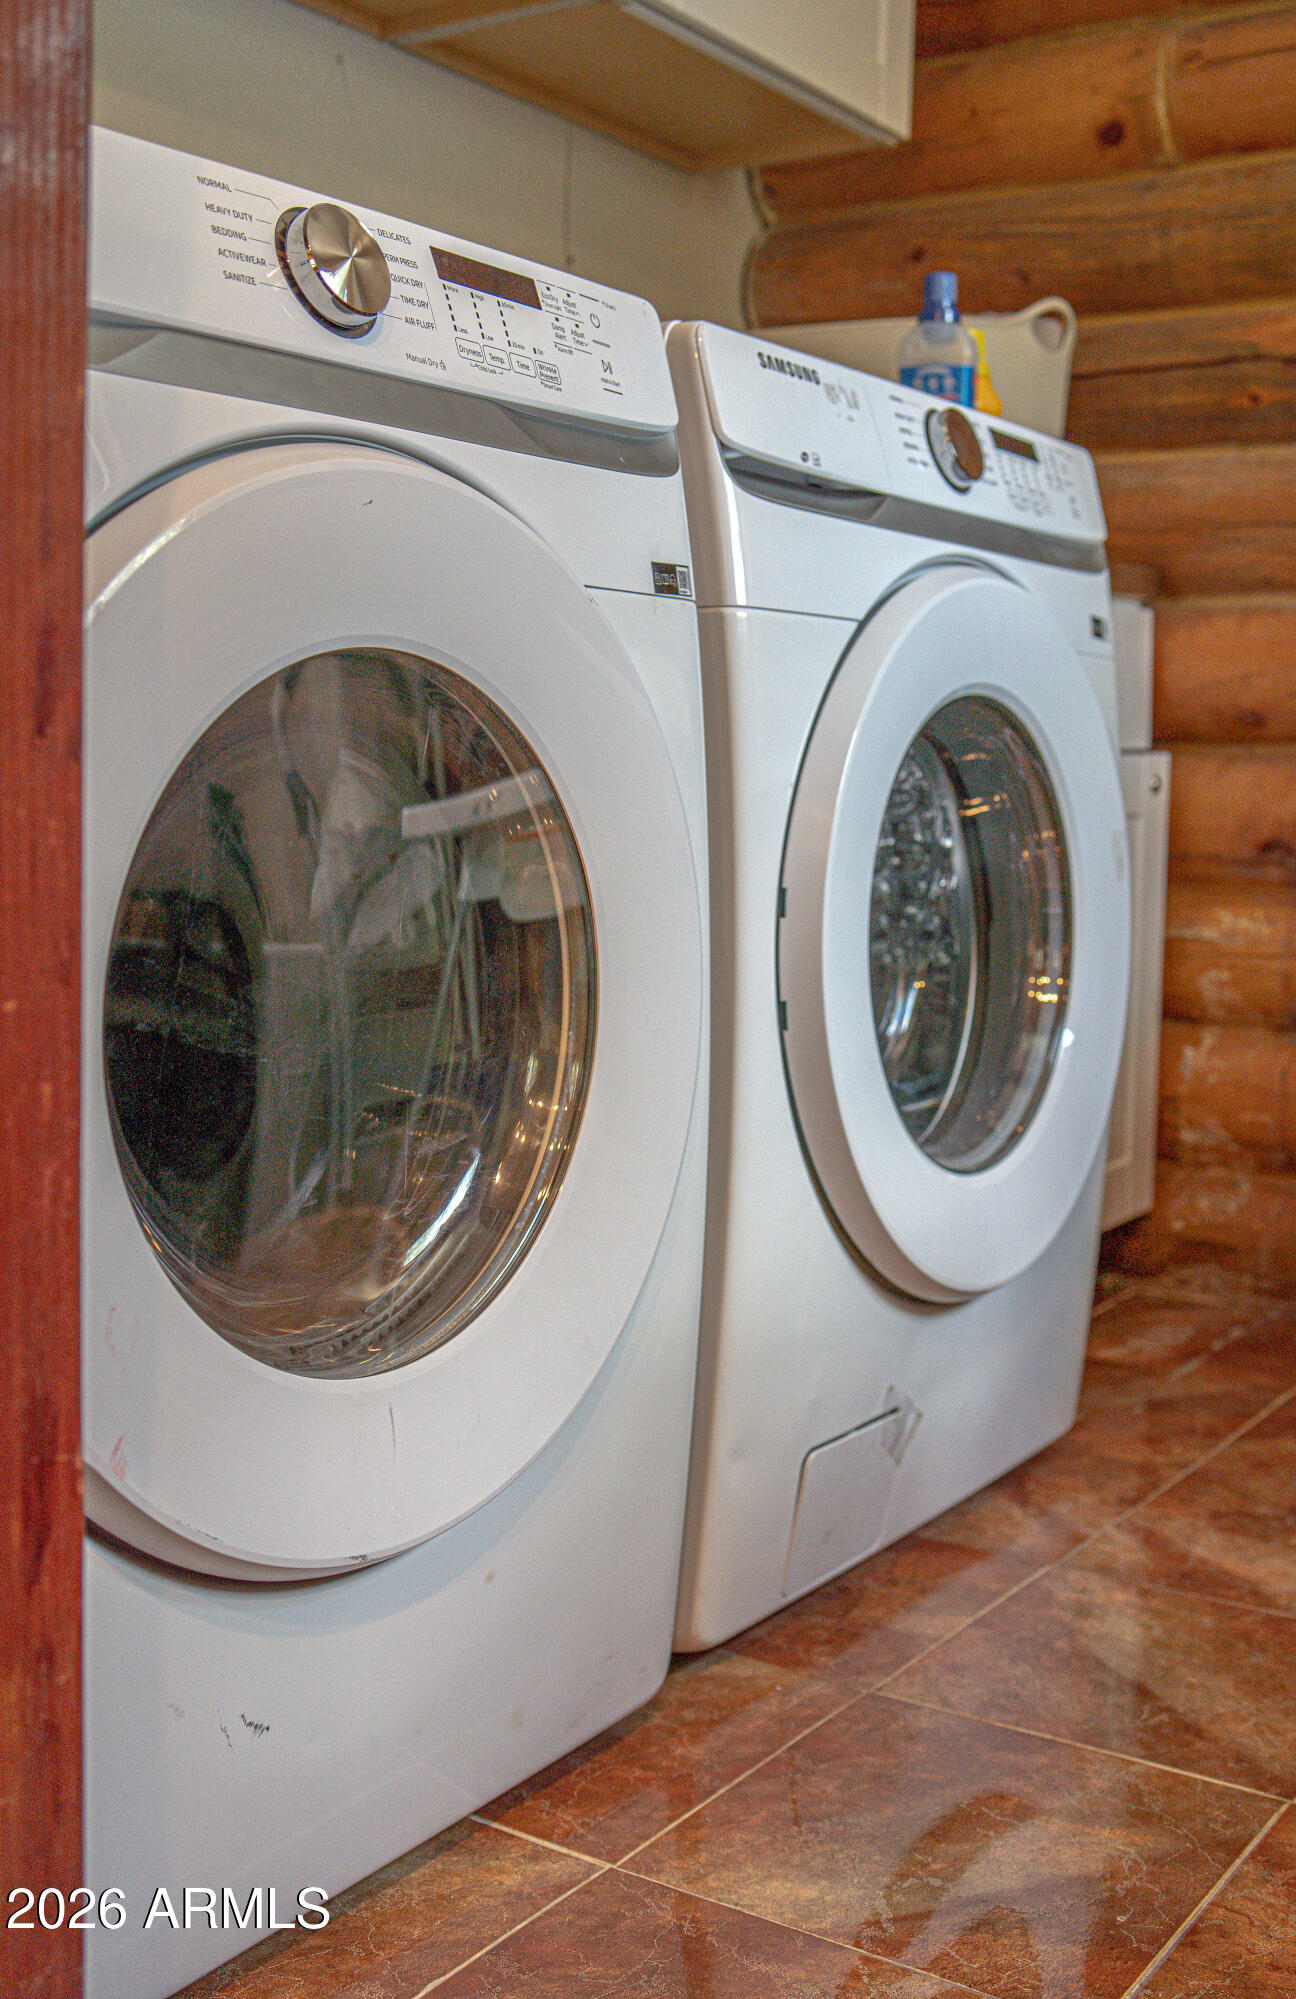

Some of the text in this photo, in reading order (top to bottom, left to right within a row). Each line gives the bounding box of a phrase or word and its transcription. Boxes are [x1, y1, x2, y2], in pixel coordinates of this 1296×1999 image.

[196, 175, 233, 193] NORMAL
[204, 202, 253, 223] HEAVY DUTY
[210, 224, 248, 242] BEDDING
[376, 228, 412, 245] DELICATES
[217, 247, 267, 268] ACTIVEWEAR
[399, 256, 419, 270] PRESS
[222, 270, 258, 286] SANITIZE
[390, 273, 424, 289] QUICK DRY
[400, 294, 429, 310] TIME DRY
[404, 316, 435, 331] AIR FLUFF
[458, 344, 482, 358] Dryness
[488, 352, 505, 365] Temp
[405, 352, 439, 369] Manual Dry
[516, 360, 530, 371] Time
[757, 351, 821, 385] SAMSUNG
